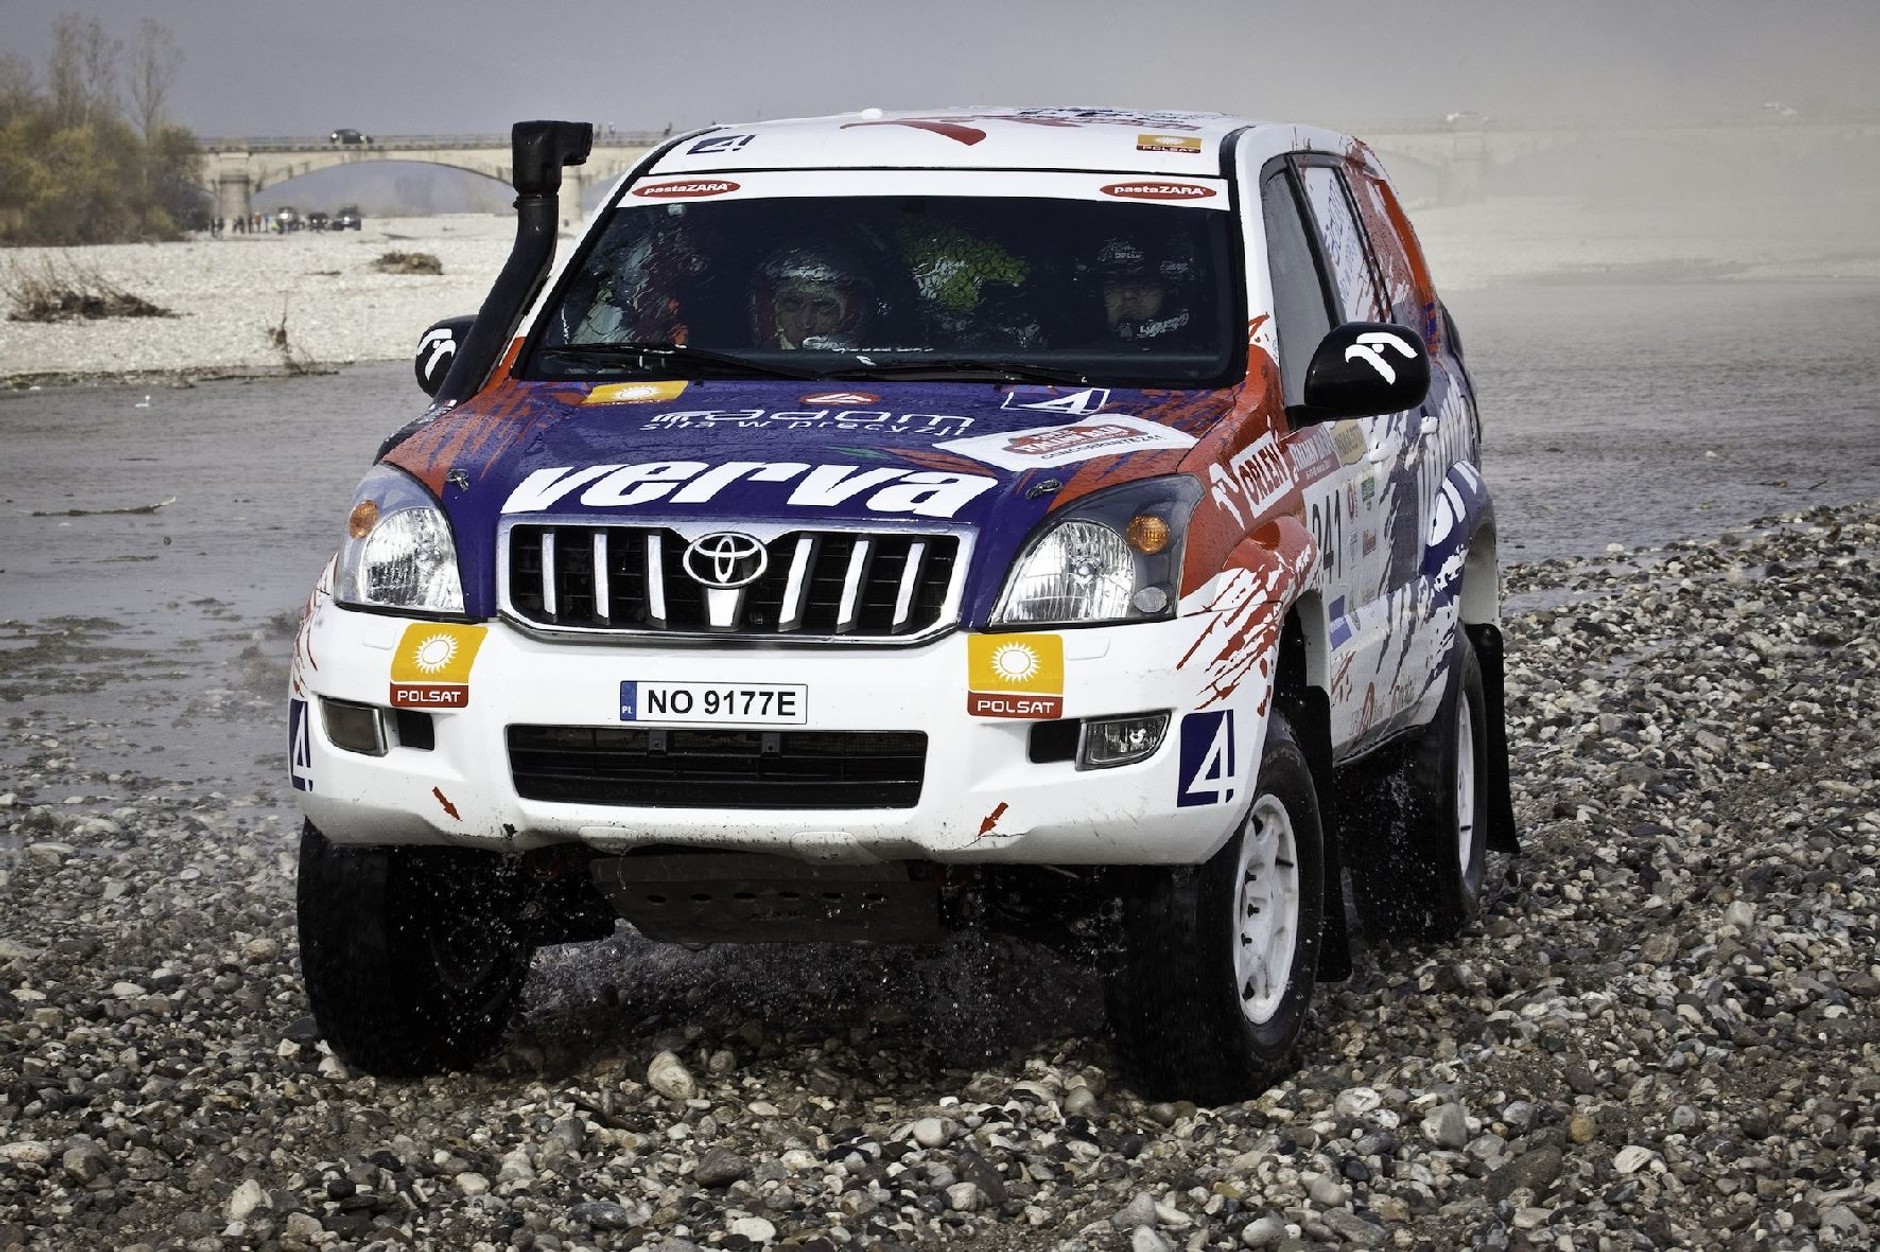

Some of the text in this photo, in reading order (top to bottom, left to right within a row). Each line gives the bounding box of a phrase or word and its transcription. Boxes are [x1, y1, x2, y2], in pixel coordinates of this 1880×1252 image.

[643, 183, 729, 195] pastaZARA
[1113, 185, 1205, 196] pastaZARA
[1238, 442, 1289, 505] ORLEN
[501, 461, 998, 517] verva
[397, 690, 461, 702] POLSAT
[621, 689, 796, 716] PL NO 9177E
[977, 700, 1055, 714] POLSAT
